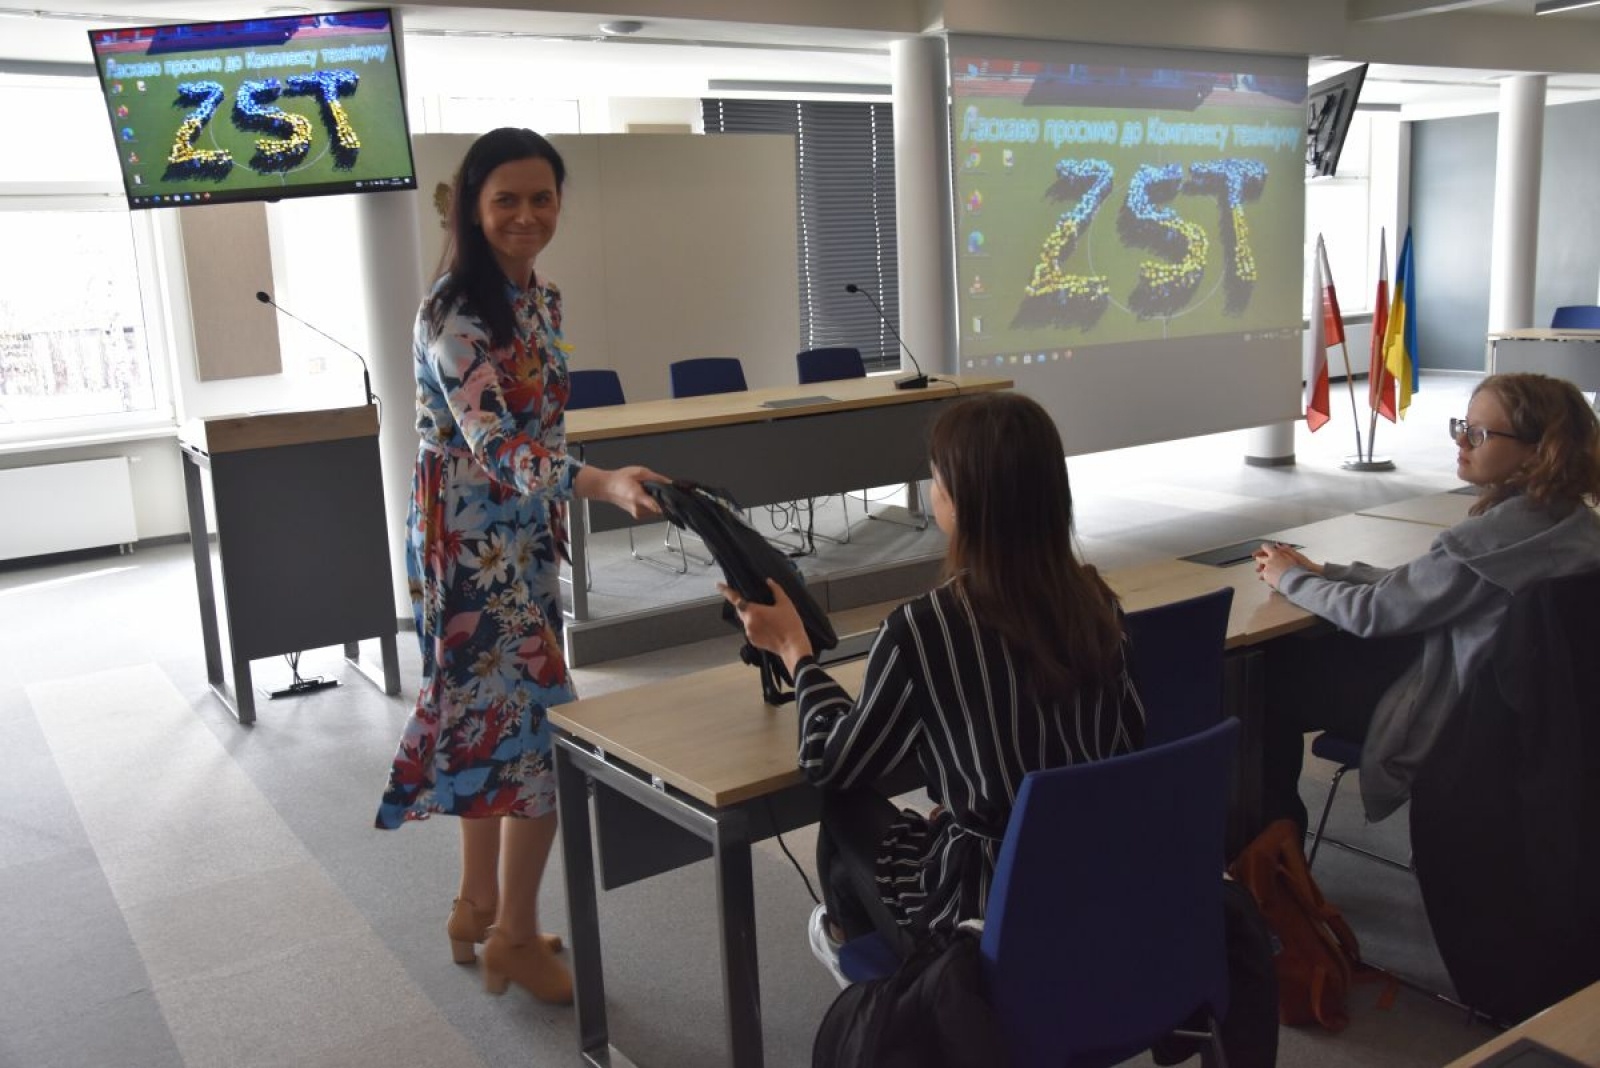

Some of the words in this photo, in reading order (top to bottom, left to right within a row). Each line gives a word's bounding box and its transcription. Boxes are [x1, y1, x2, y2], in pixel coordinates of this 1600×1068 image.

[224, 55, 242, 73] до
[168, 68, 361, 164] ZST
[1044, 119, 1117, 149] просимо
[1120, 121, 1143, 148] до
[1147, 117, 1229, 151] Комплексу
[1025, 157, 1269, 301] ZST
